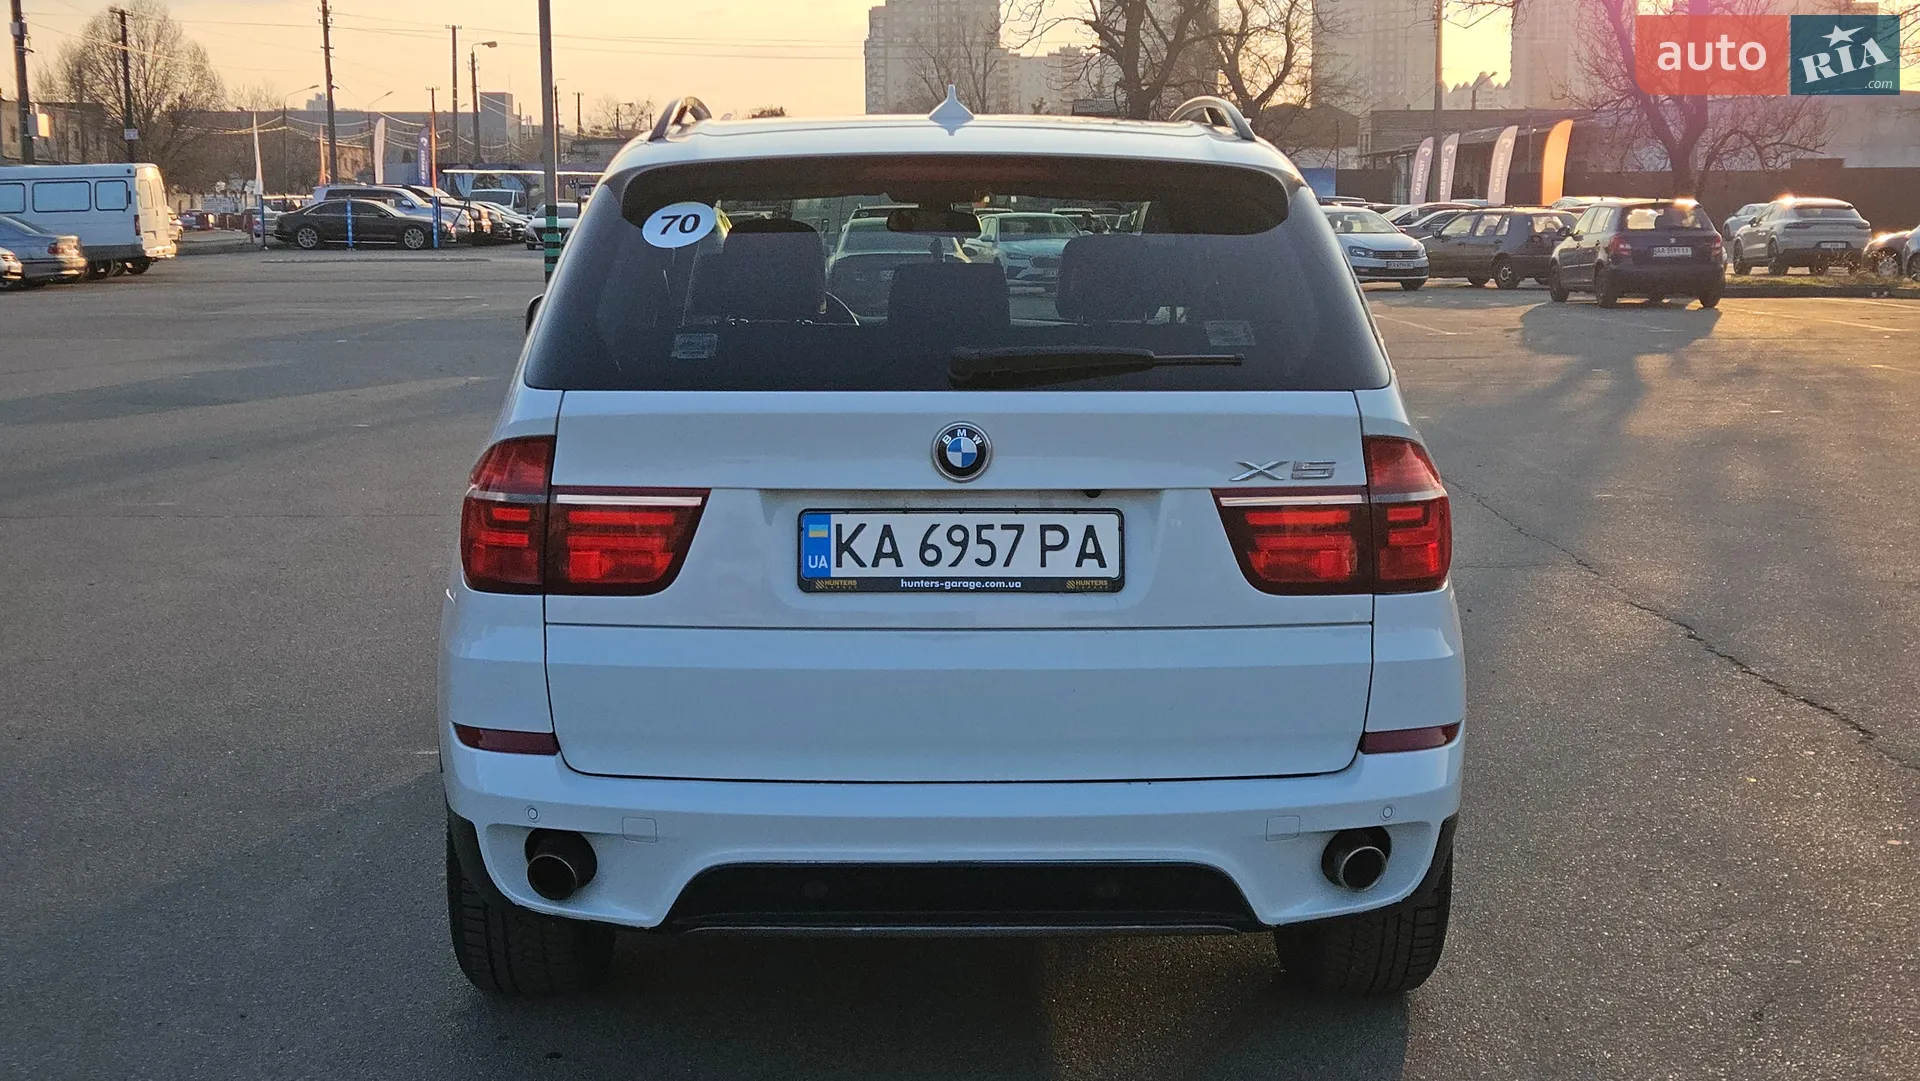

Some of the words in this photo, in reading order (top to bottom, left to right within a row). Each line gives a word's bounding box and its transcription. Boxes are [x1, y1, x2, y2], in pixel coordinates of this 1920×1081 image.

[1496, 153, 1504, 177] INVEST
[660, 213, 701, 235] 70
[942, 429, 982, 445] BMW
[1229, 460, 1337, 481] X5
[835, 523, 904, 568] KA
[918, 523, 1025, 568] 6957
[1039, 523, 1107, 568] PA
[808, 555, 828, 568] UA
[900, 579, 1022, 590] hunters-garage.com.ua
